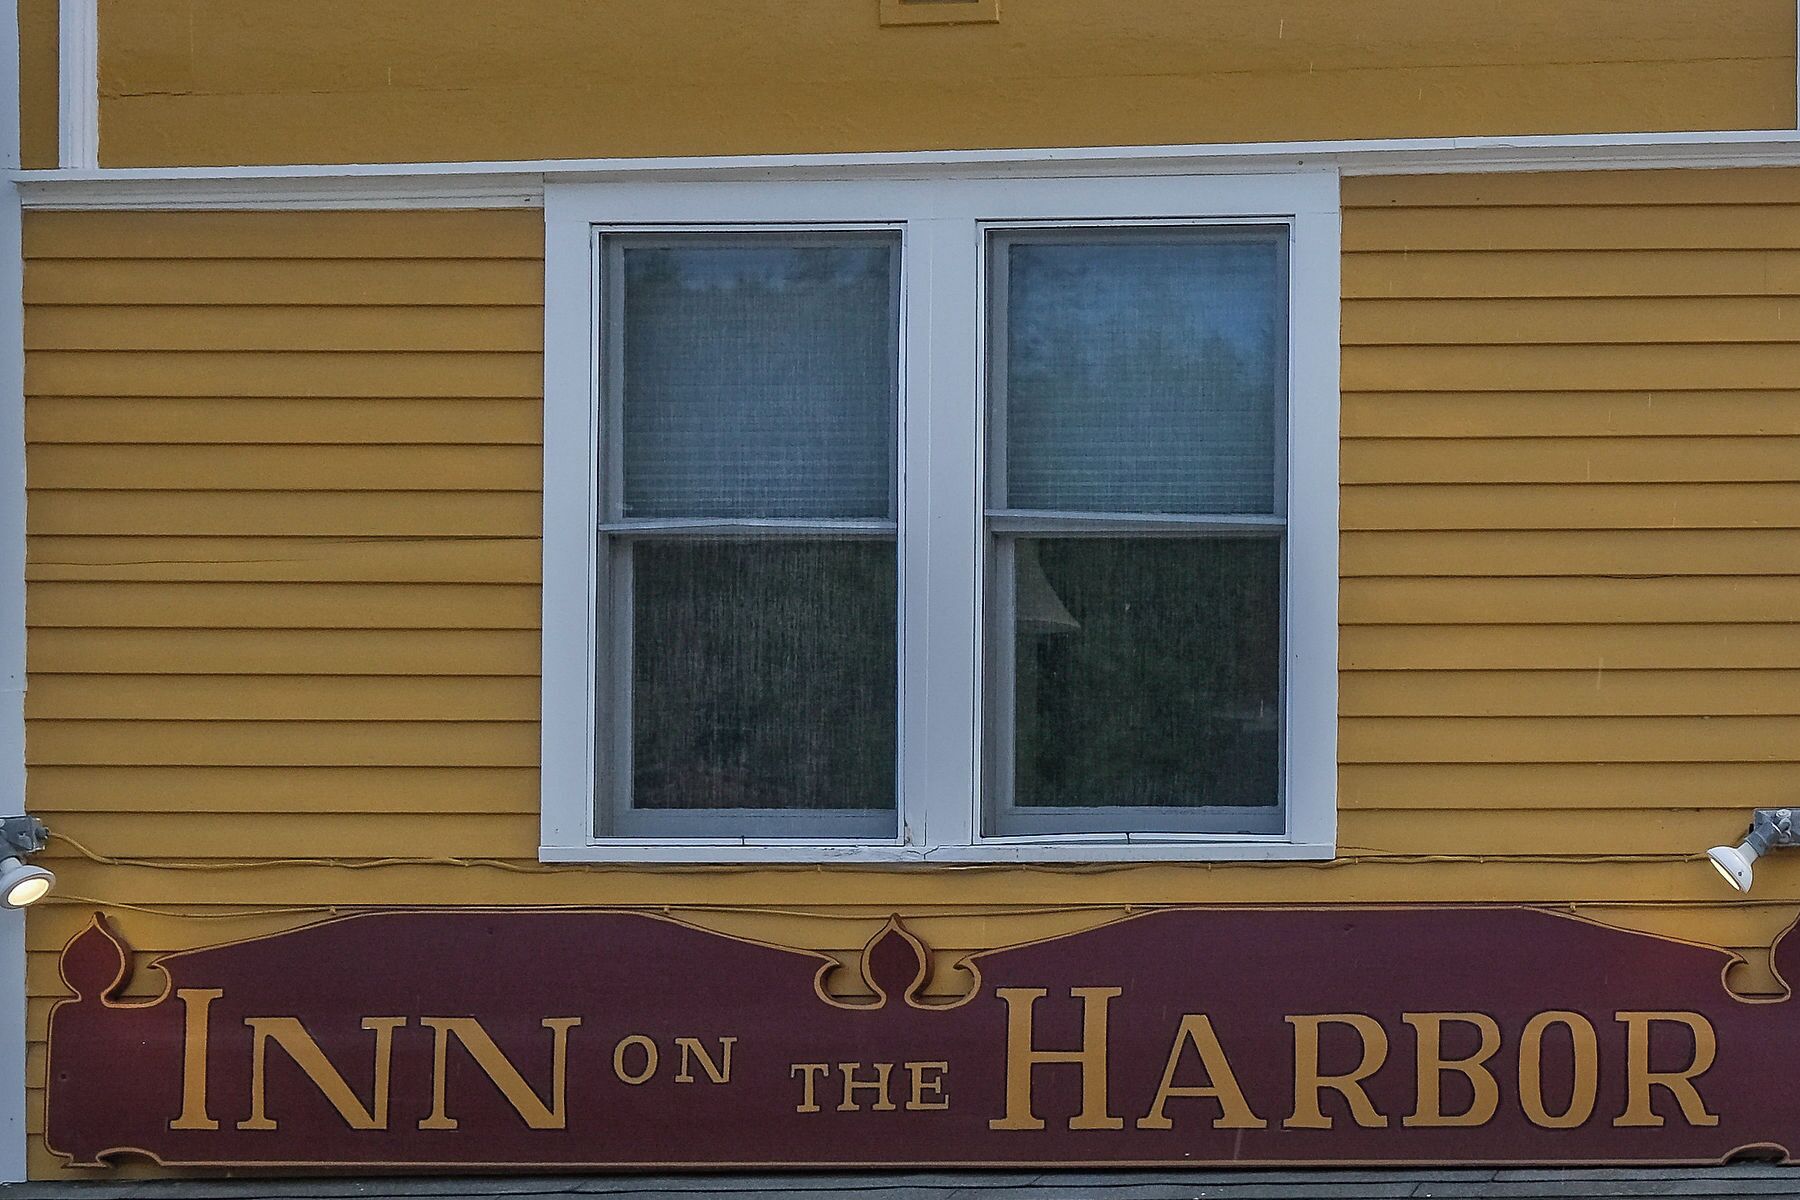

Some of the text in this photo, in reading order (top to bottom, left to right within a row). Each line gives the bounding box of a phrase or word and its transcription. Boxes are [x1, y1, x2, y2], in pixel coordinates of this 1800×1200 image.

[169, 986, 1720, 1131] INN ON THE HARBOR
